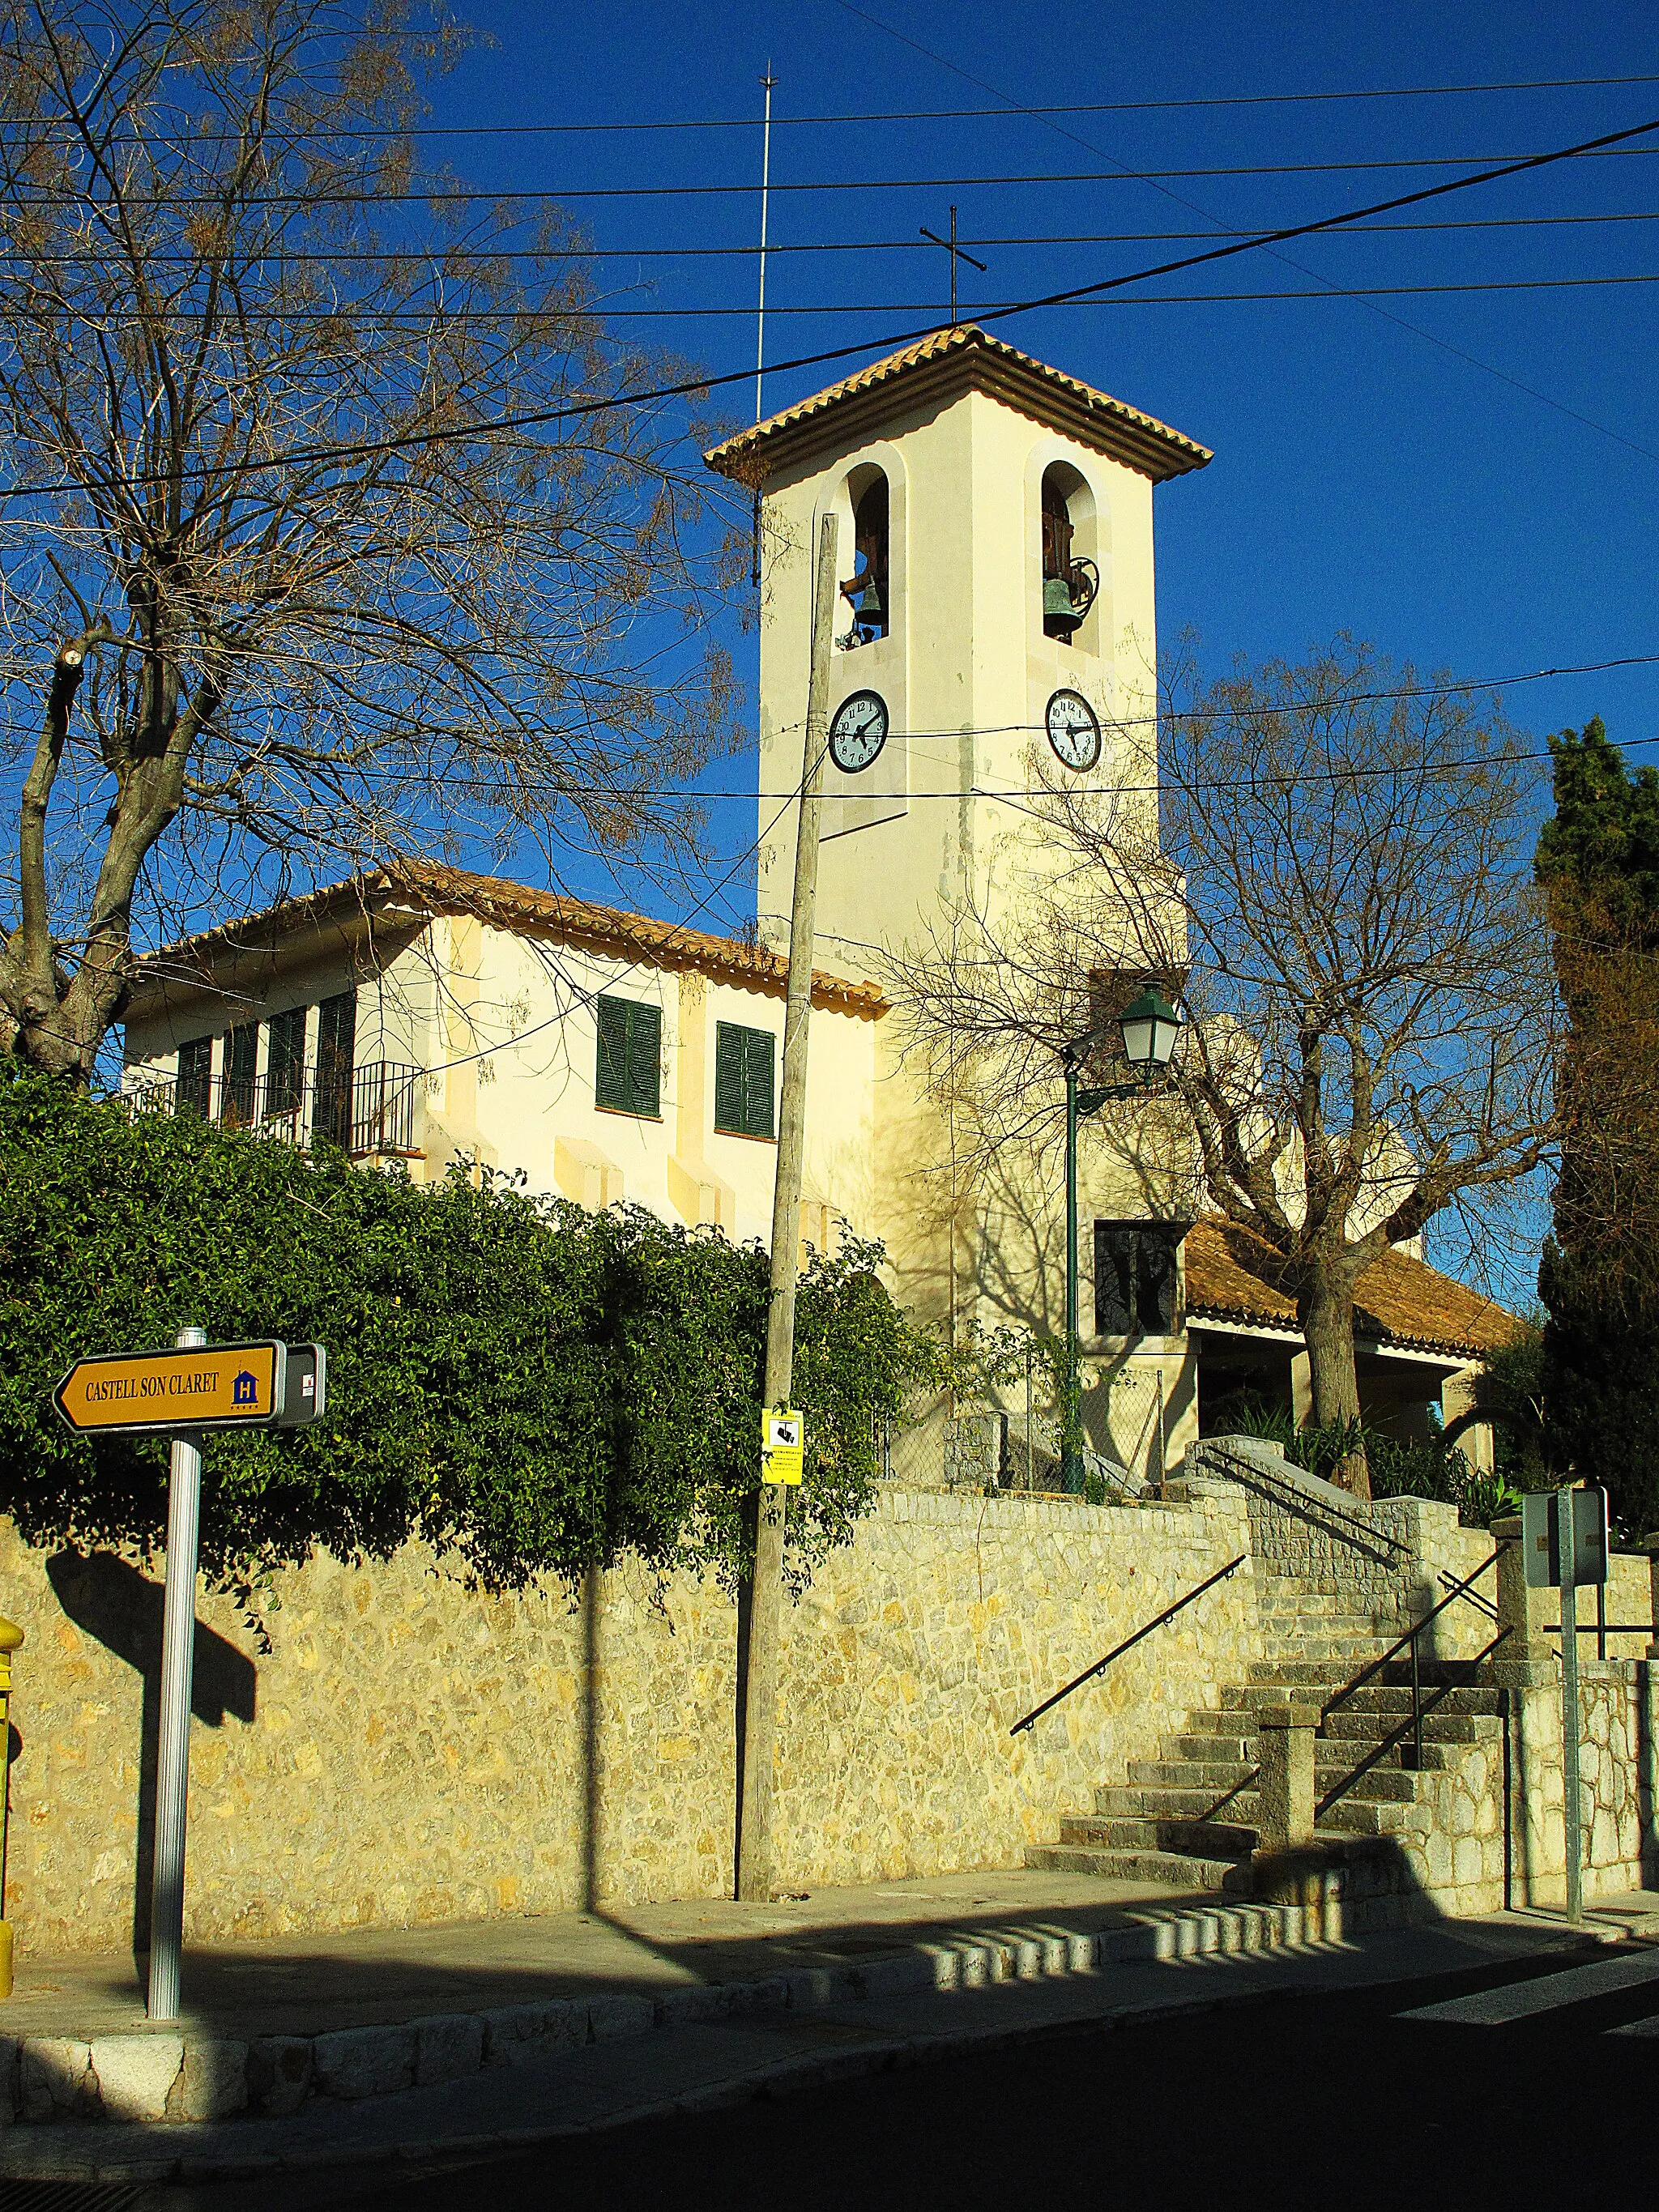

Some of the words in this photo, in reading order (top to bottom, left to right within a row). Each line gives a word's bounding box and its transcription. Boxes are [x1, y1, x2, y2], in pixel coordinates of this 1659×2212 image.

[857, 702, 866, 712] 12
[869, 702, 872, 712] 1
[1060, 701, 1066, 712] 11
[1068, 701, 1075, 712] 12
[849, 710, 855, 719] 11
[1052, 707, 1060, 718] 10
[839, 722, 849, 731] 10
[876, 722, 882, 731] 3
[839, 734, 846, 744] 9
[1052, 733, 1058, 743] 8
[842, 746, 847, 755] 8
[868, 747, 873, 756] 5
[1060, 745, 1065, 754] 7
[849, 753, 855, 762] 7
[859, 753, 864, 763] 6
[1067, 752, 1073, 761] 6
[85, 1379, 139, 1402] CASTELL
[140, 1376, 168, 1397] SON
[168, 1371, 220, 1396] CLARET
[240, 1381, 250, 1399] H
